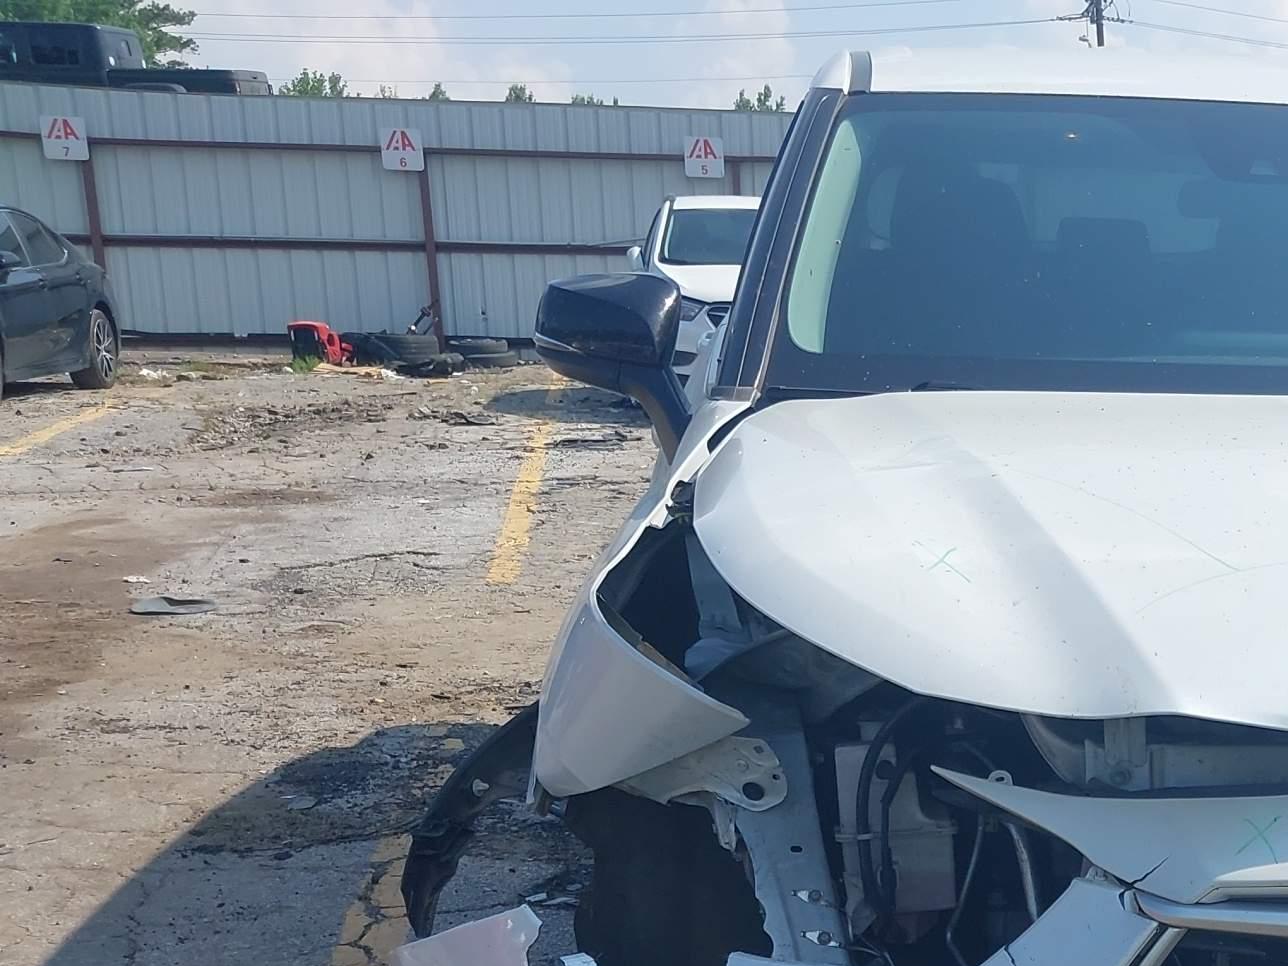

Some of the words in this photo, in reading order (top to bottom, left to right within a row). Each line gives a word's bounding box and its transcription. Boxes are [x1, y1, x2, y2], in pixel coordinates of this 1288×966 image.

[61, 146, 70, 157] 7
[399, 157, 408, 168] 6
[701, 164, 709, 176] 5
